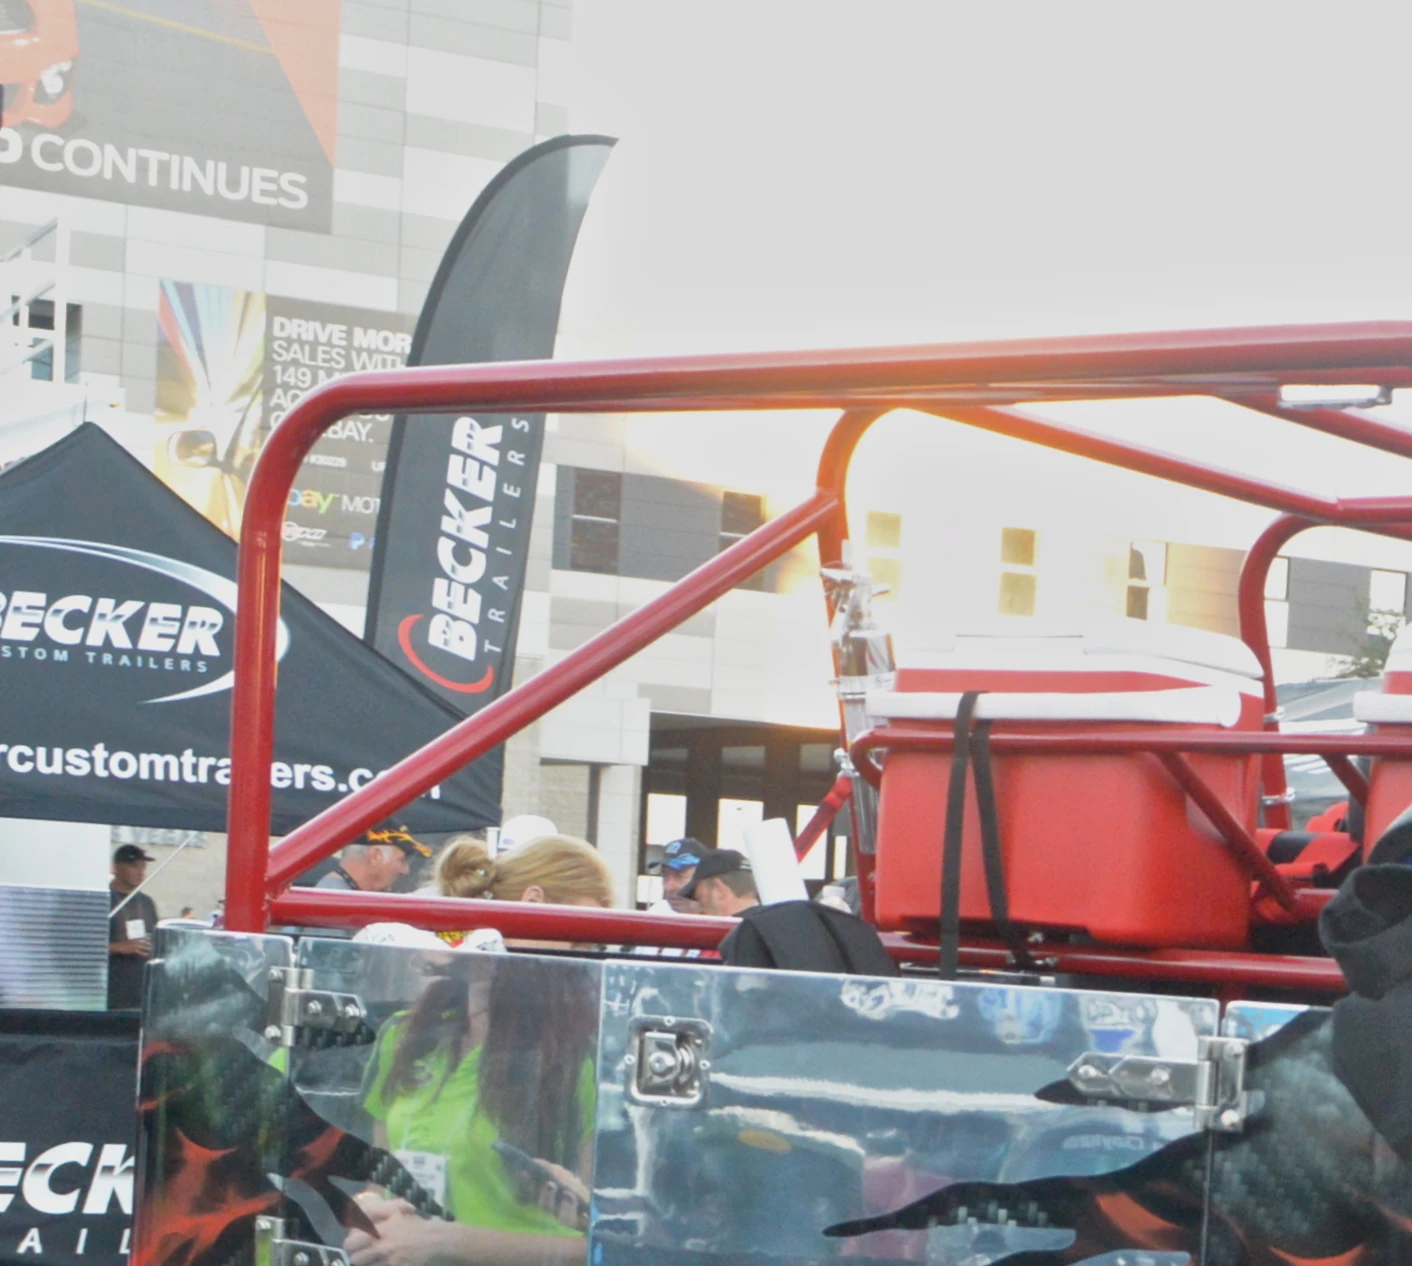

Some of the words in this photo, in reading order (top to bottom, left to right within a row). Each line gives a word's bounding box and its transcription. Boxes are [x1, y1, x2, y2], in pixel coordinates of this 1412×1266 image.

[30, 133, 308, 210] CONTINUES
[272, 316, 347, 347] DRIVE
[272, 340, 346, 369] SALES
[274, 365, 312, 388] 149
[321, 421, 374, 443] BAY.
[428, 416, 503, 661] BECKER
[484, 417, 530, 653] TRAILERS
[0, 591, 224, 657] ECKER
[86, 652, 208, 672] TRAILERS
